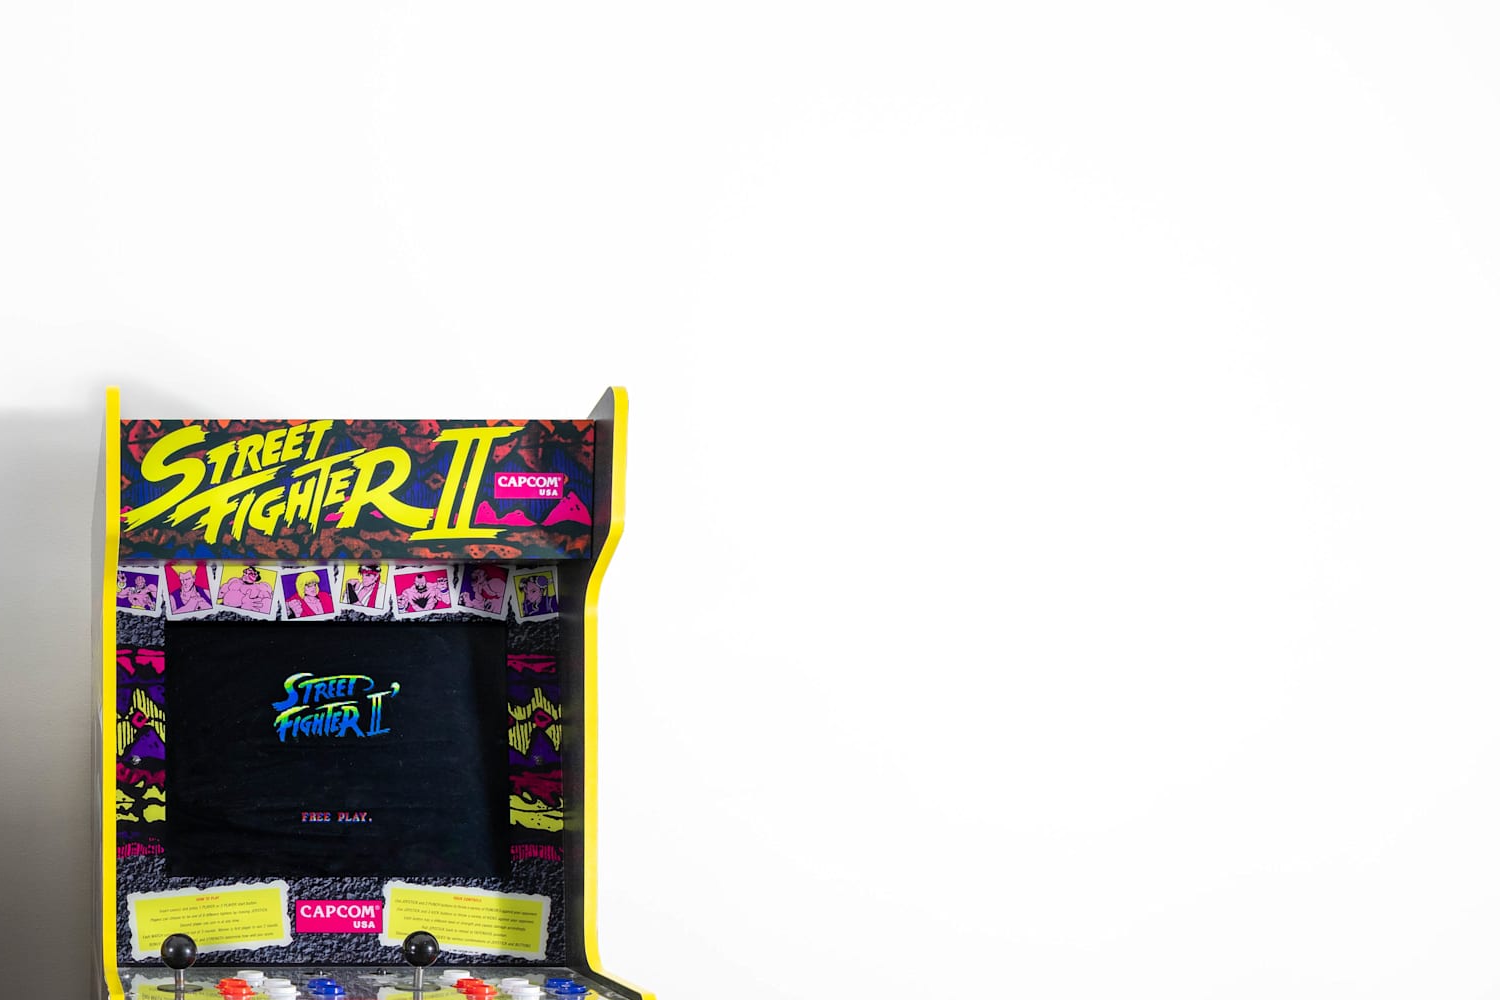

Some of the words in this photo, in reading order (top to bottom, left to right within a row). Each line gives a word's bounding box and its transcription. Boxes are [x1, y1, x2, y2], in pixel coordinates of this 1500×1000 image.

[124, 419, 333, 533] STREET
[167, 447, 435, 545] FIGHTER
[407, 426, 526, 541] II
[272, 673, 374, 711] STREET
[273, 701, 365, 742] FIGHTER
[301, 812, 331, 822] FREE
[338, 812, 372, 822] PLAY.
[353, 920, 376, 929] USA
